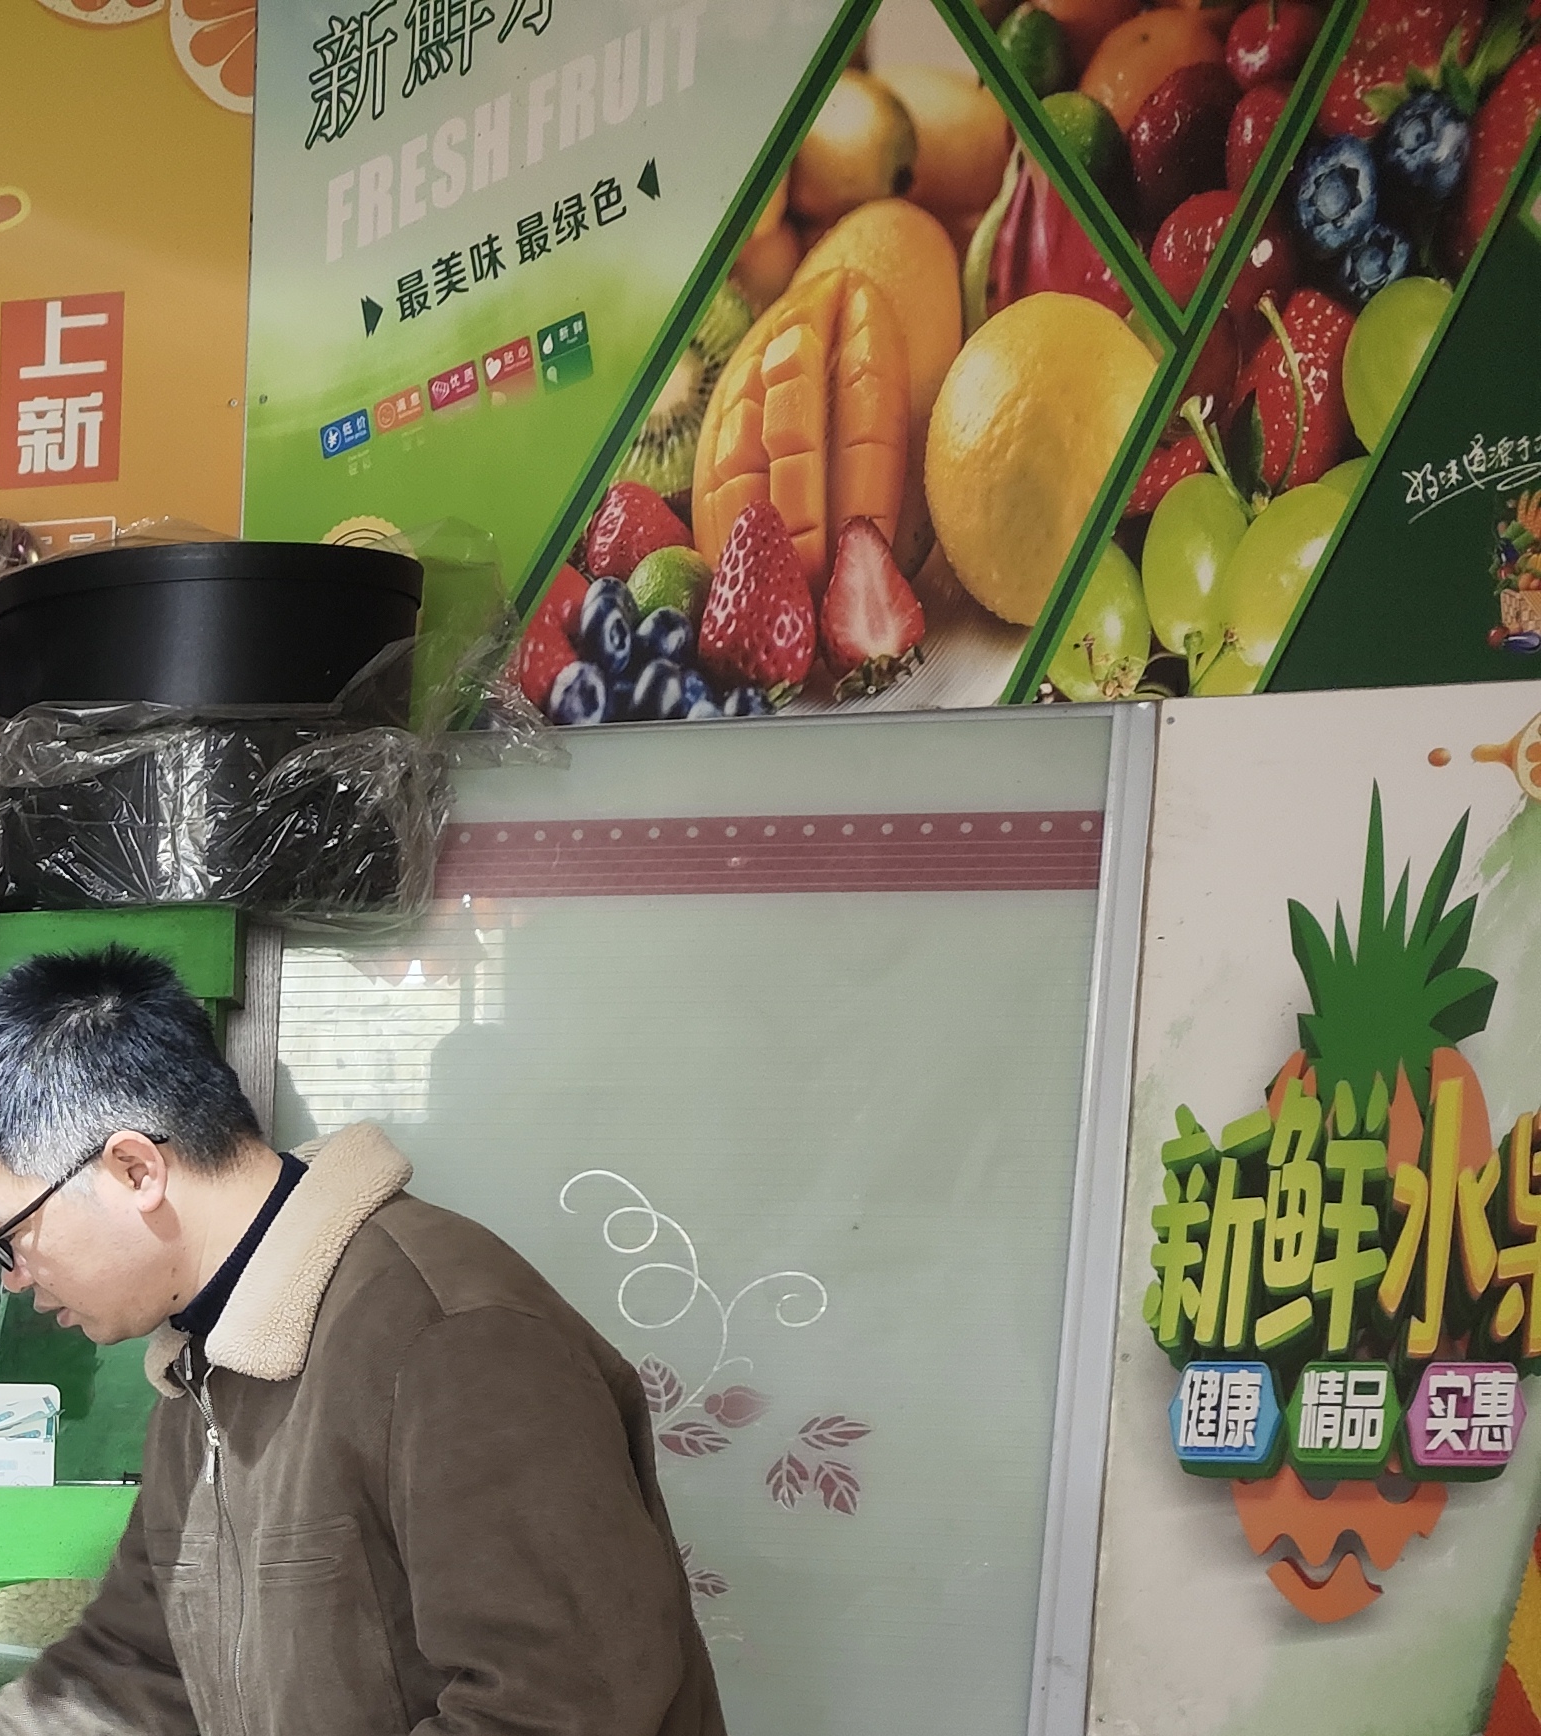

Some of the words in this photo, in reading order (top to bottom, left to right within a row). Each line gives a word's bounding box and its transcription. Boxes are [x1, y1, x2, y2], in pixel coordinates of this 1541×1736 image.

[305, 0, 552, 149] 新鲜
[325, 95, 512, 263] FRESH
[526, 9, 711, 165] FRUIT
[396, 235, 506, 323] 最美味
[517, 178, 627, 264] 最绿色
[14, 300, 105, 475] 上新
[1179, 1369, 1263, 1448] 健康
[1298, 1369, 1388, 1450] 精品
[1425, 1369, 1518, 1452] 实惠
